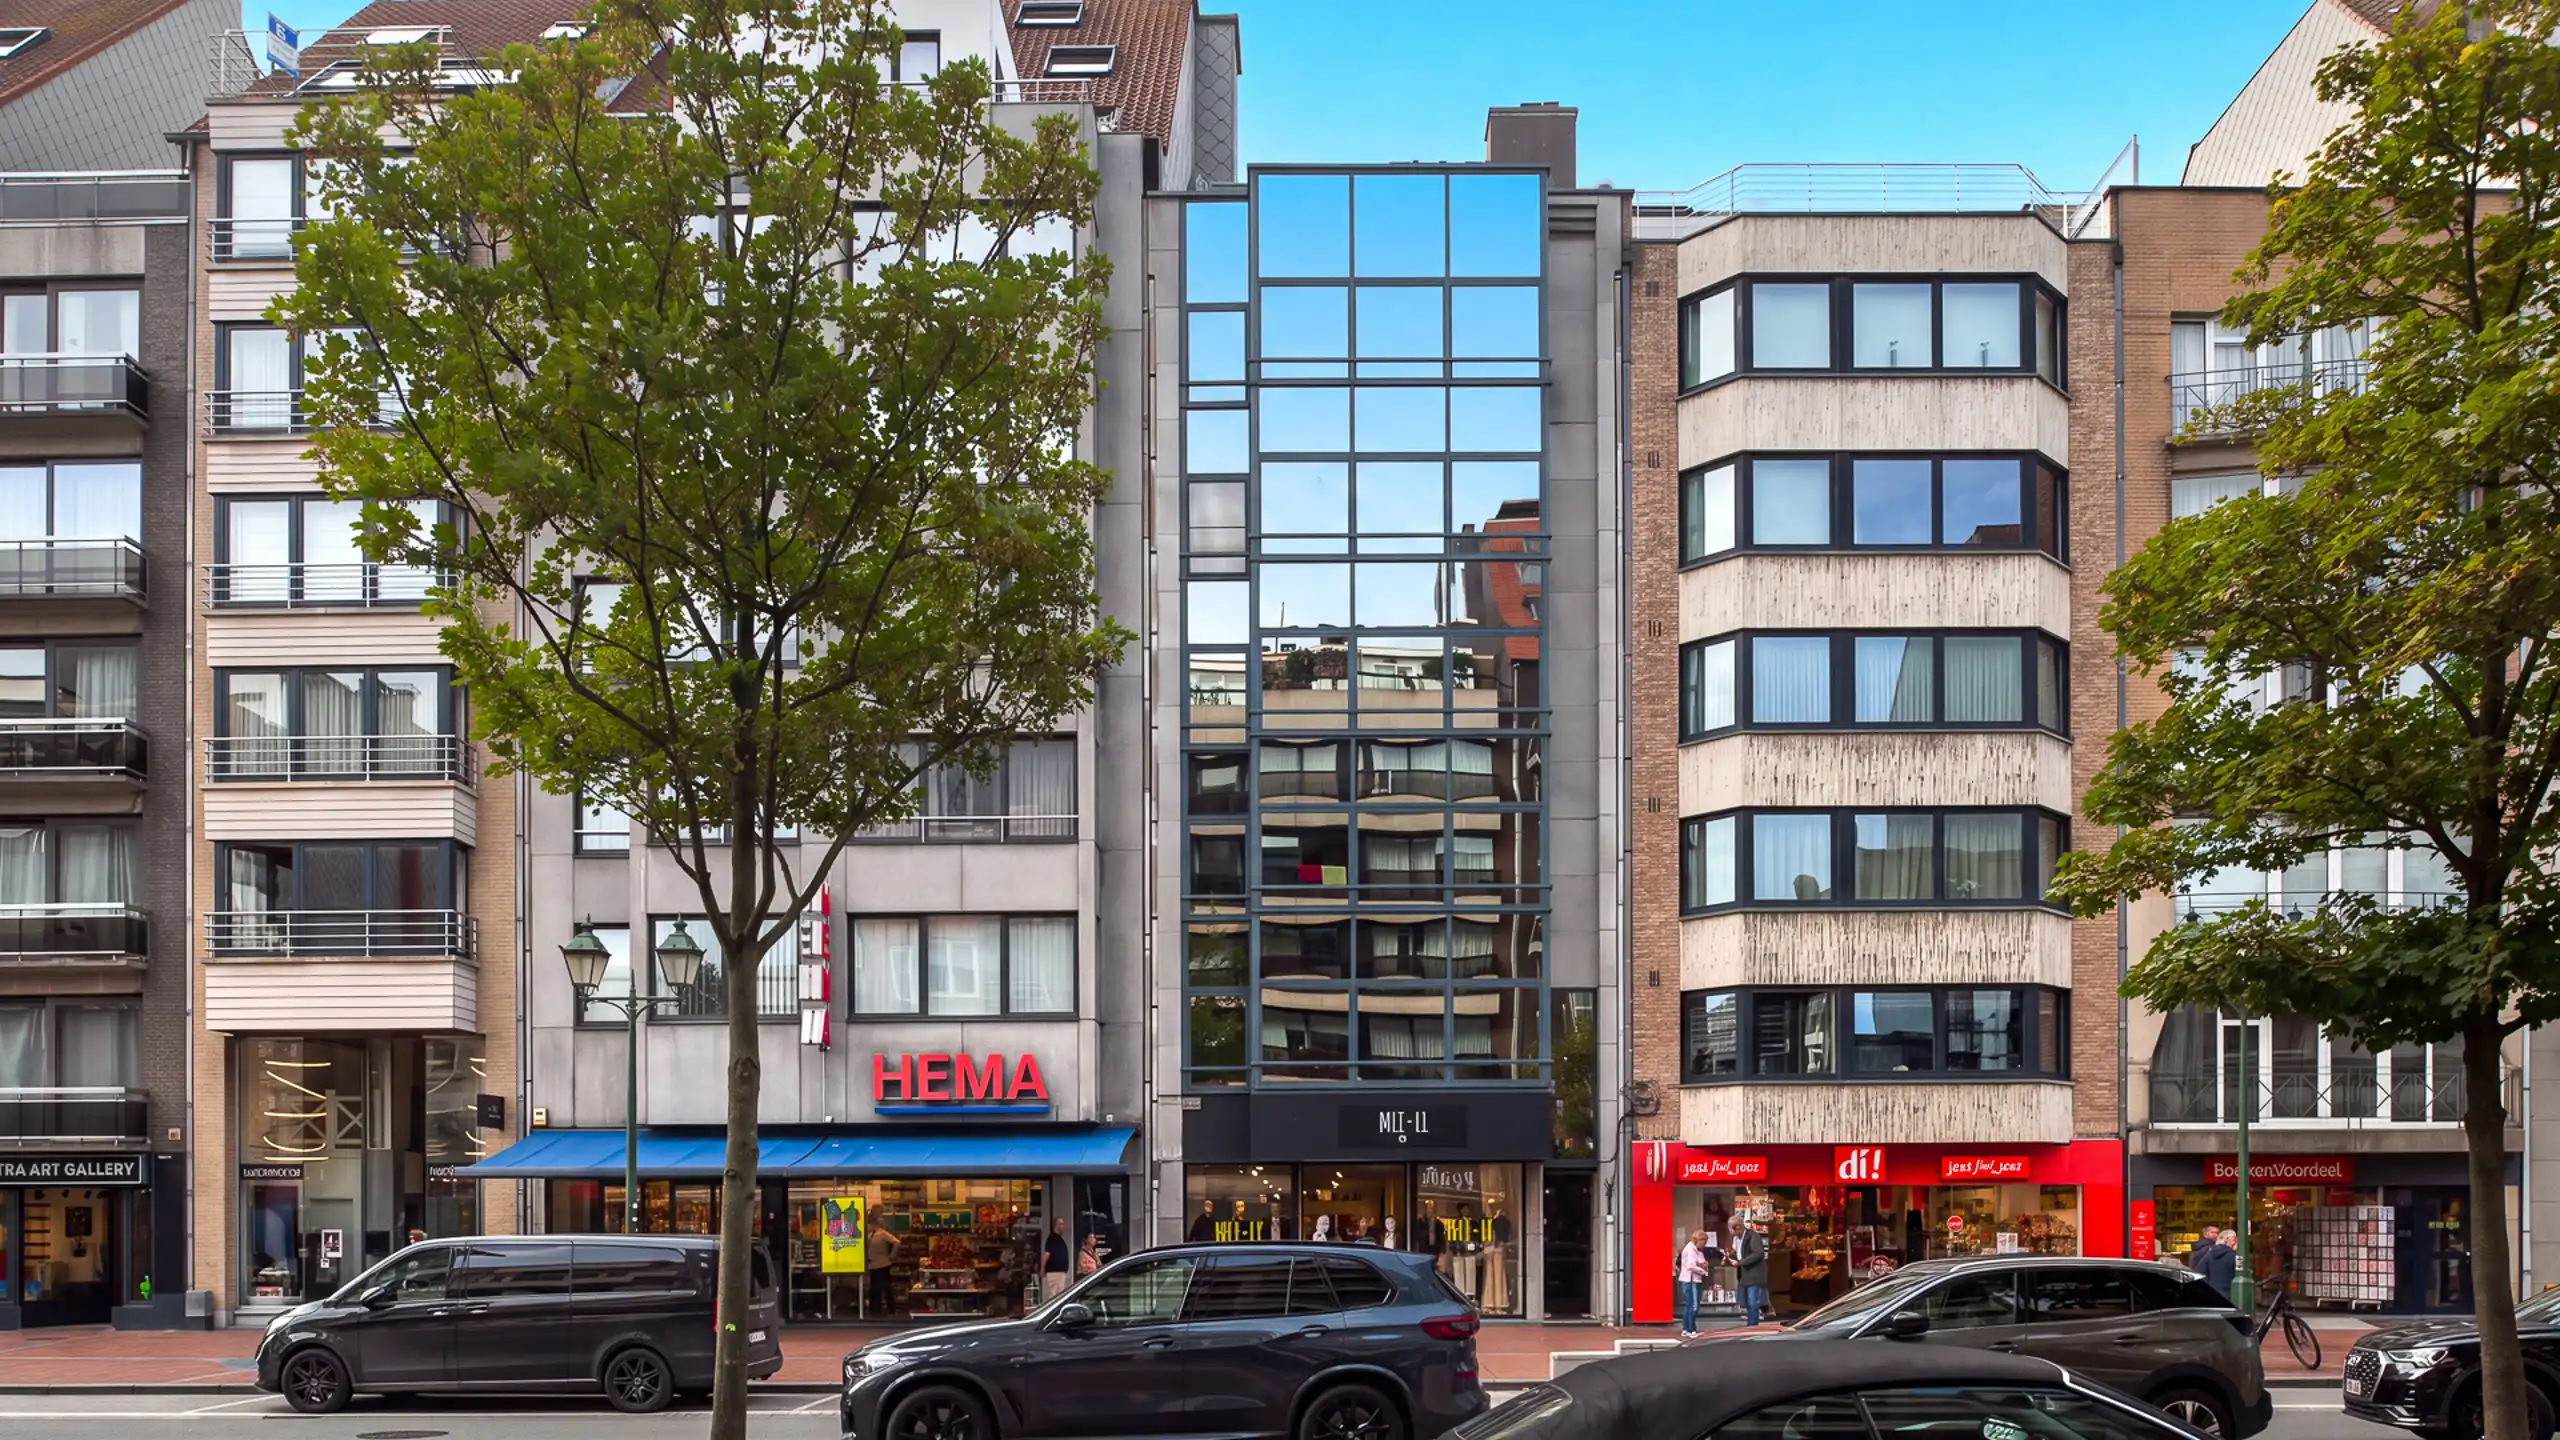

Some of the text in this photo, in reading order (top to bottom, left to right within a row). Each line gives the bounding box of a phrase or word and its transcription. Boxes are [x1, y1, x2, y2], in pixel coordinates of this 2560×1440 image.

[872, 1053, 1048, 1100] HEMA
[29, 1163, 61, 1176] ART
[64, 1162, 134, 1176] GALLERY
